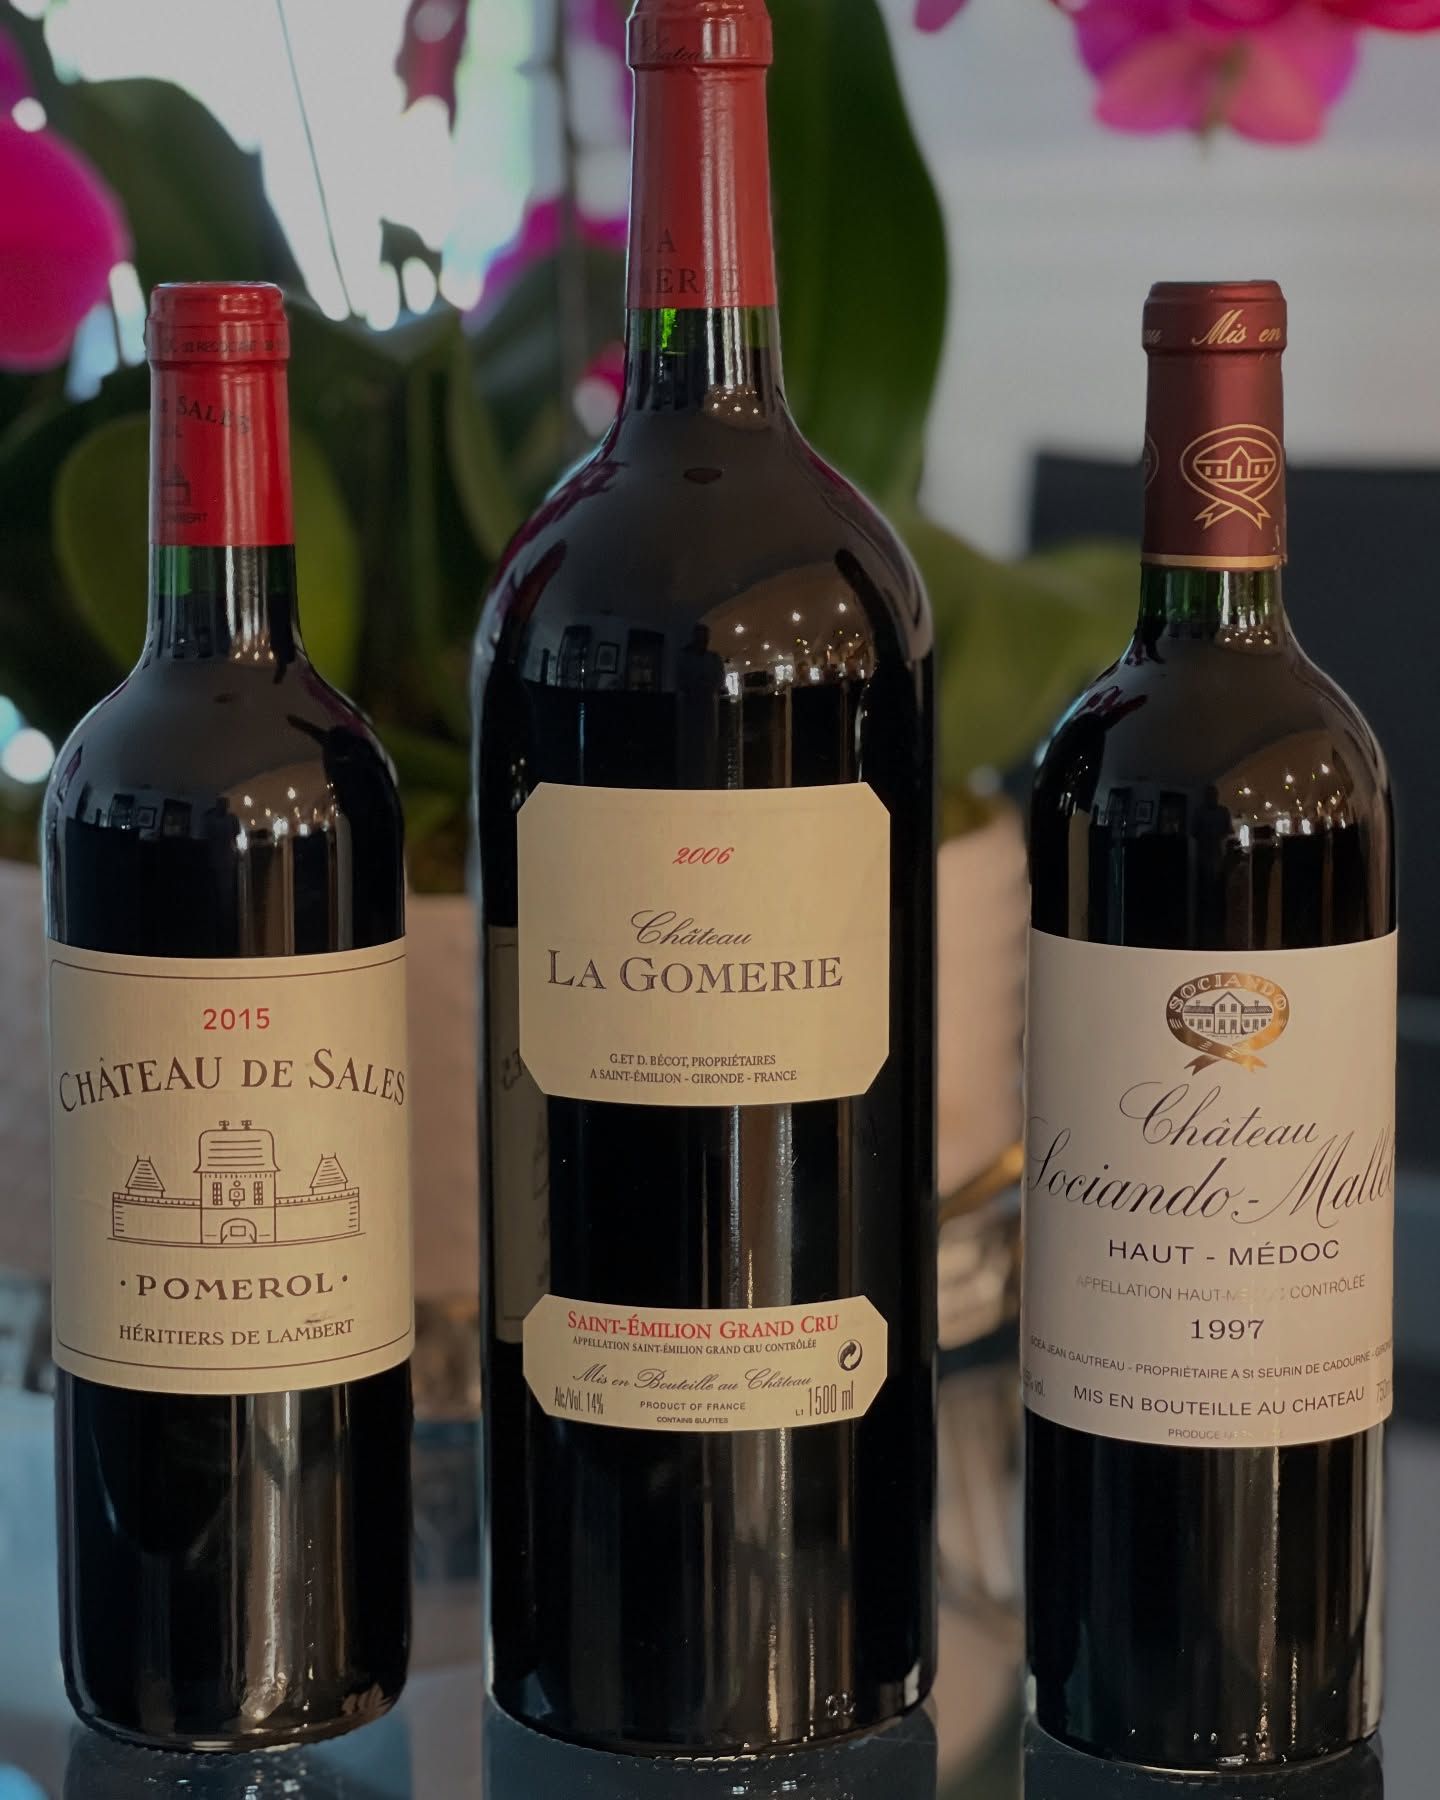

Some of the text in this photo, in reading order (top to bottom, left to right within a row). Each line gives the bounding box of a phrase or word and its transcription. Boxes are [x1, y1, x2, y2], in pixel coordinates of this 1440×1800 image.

[1191, 309, 1247, 345] Mis
[672, 847, 735, 865] 2006
[631, 910, 752, 945] Château
[547, 949, 843, 993] LA GOMERIE
[1169, 974, 1287, 1013] SOCIANDO
[203, 1008, 270, 1030] 2015
[691, 1054, 776, 1068] PROPRIÉTAIRES
[59, 1048, 405, 1112] CHÂTEAU DE SALES
[599, 1069, 681, 1083] SAINT-ÉMILION
[691, 1073, 744, 1084] GIRONDE
[754, 1070, 797, 1083] FRANCE
[1119, 1081, 1319, 1147] Château
[1108, 1239, 1194, 1265] HAUT
[1229, 1240, 1340, 1266] MÉDOC
[136, 1272, 333, 1301] POMEROL
[1076, 1275, 1172, 1300] APPELLATION
[119, 1318, 355, 1346] HÉRITIERS DE LAMBERT
[568, 1310, 839, 1340] SAINT-ÉMILION GRAND CRU
[1191, 1319, 1264, 1340] 1997
[573, 1336, 816, 1355] APPELLATION SAINT-ÉMILION GRAND CRU CONTRÔLÉE
[572, 1363, 813, 1391] Mis en Bouteille au Château
[1068, 1350, 1125, 1371] GAUTREAU
[1136, 1363, 1228, 1379] PROPRIÉTAIRE
[1257, 1366, 1302, 1379] SEURIN
[1305, 1363, 1320, 1375] DE
[1322, 1351, 1371, 1373] CADOURNE
[640, 1401, 746, 1411] PRODUCT OF FRANCE
[808, 1380, 854, 1417] 1500 ml
[1074, 1385, 1365, 1416] MIS EN BOUTEILLE AU CHATEAU
[657, 1416, 693, 1424] CONTAINS
